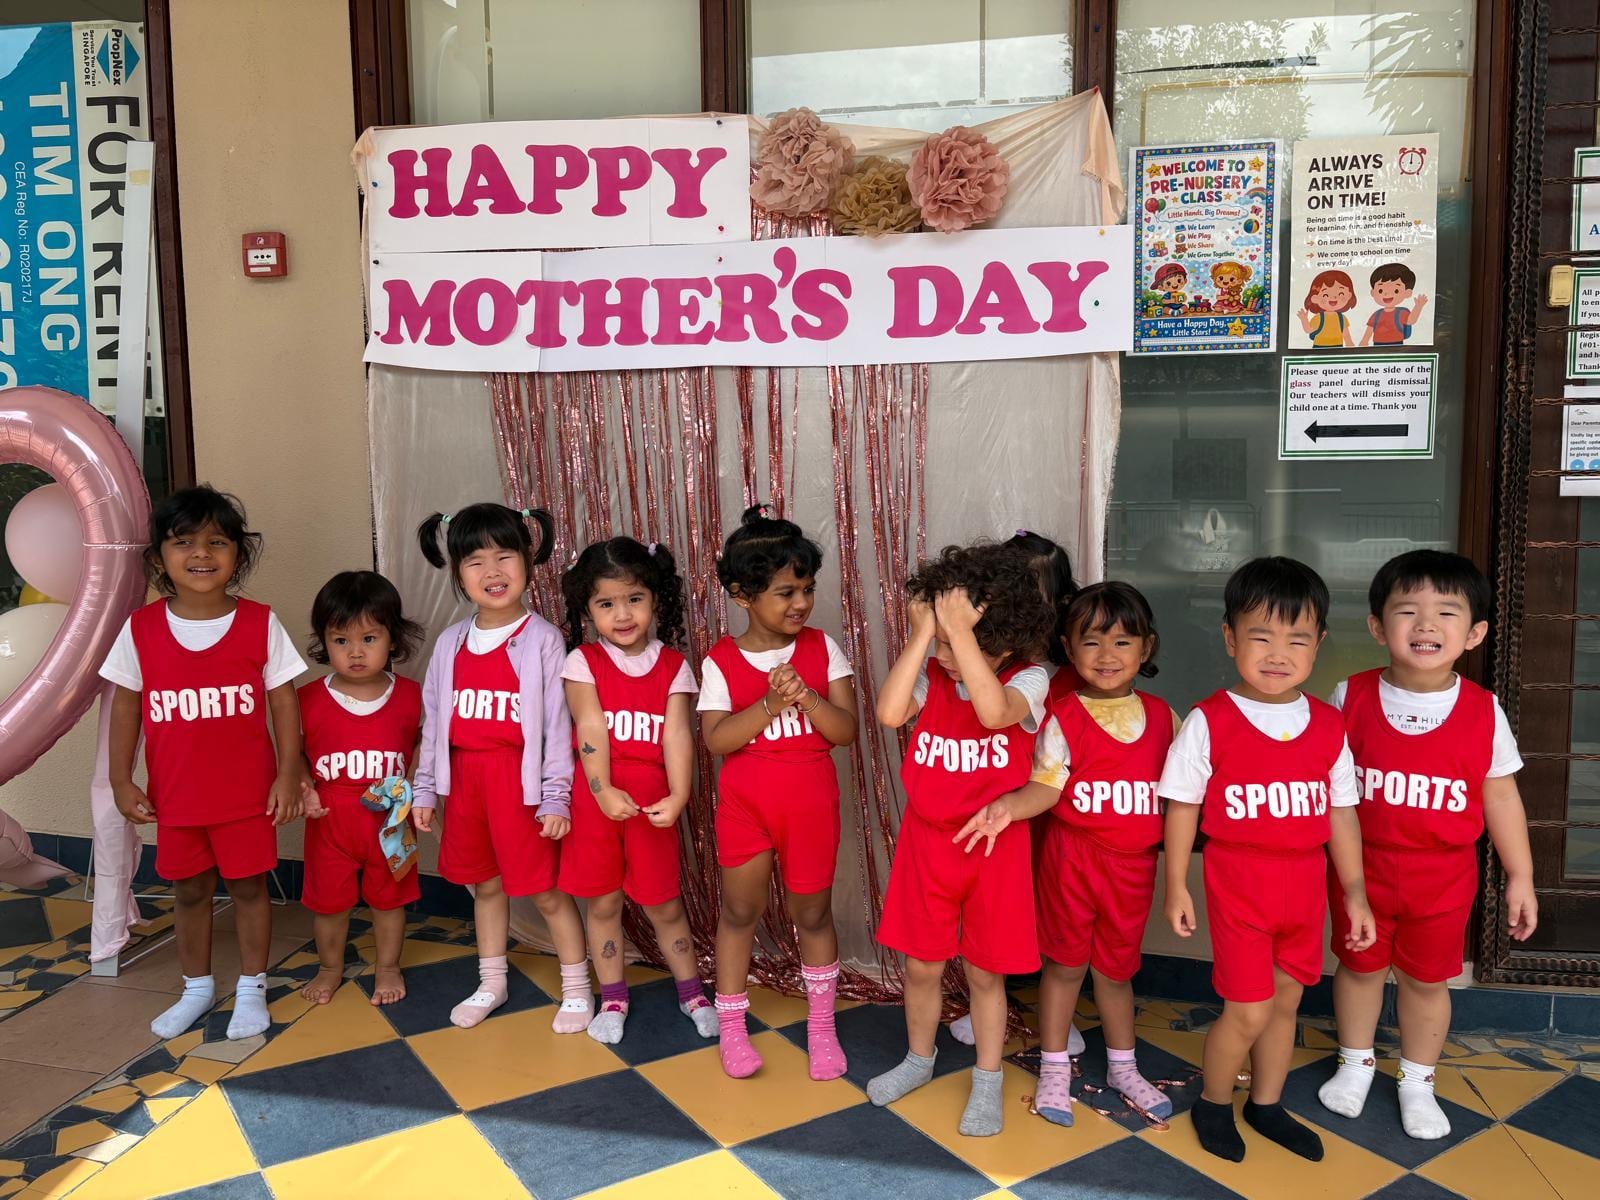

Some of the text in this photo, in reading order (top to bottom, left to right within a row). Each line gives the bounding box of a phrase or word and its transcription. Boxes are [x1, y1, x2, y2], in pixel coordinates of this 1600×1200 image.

[82, 32, 91, 86] SINGAPORE
[110, 28, 123, 86] PropNex
[1162, 157, 1246, 177] WELCOME TO
[1308, 153, 1384, 173] ALWAYS
[387, 143, 728, 219] HAPPY
[1150, 175, 1252, 195] PRE-NURSERY
[1307, 173, 1374, 192] ARRIVE
[1180, 190, 1223, 205] CLASS
[1307, 191, 1386, 210] ON TIME!
[29, 81, 81, 351] TIM ONG
[1167, 207, 1241, 219] Little Hands, Big Dreams!
[1306, 216, 1326, 225] Being
[1338, 214, 1353, 222] time
[1368, 213, 1386, 222] good
[1387, 211, 1406, 220] habit
[14, 161, 33, 303] CEA Reg No: R020217J
[1198, 223, 1216, 231] Learn
[1306, 225, 1316, 233] for
[1363, 221, 1377, 230] and
[1378, 219, 1413, 229] friendship
[1198, 232, 1212, 241] Play
[1317, 238, 1328, 246] On
[1329, 237, 1346, 245] time
[1346, 236, 1353, 244] is
[1354, 235, 1366, 244] the
[1213, 250, 1236, 260] Together
[1317, 251, 1329, 259] We
[1359, 247, 1384, 256] school
[1395, 246, 1411, 254] time
[1317, 259, 1336, 268] every
[381, 246, 1110, 349] MOTHER'S DAY
[1582, 288, 1593, 296] All
[1581, 310, 1588, 318] If
[1157, 320, 1176, 329] Have
[1184, 318, 1208, 330] Happy
[1209, 318, 1227, 328] Day,
[1172, 328, 1211, 337] Little Stars!
[1578, 351, 1593, 359] and
[1290, 364, 1431, 377] Please queue at the side of the
[1290, 376, 1431, 390] glass panel during dismissal.
[1289, 389, 1431, 400] Our teachers will dismiss your
[1289, 403, 1311, 412] child
[1312, 403, 1329, 411] one
[1330, 403, 1339, 411] at
[1347, 402, 1370, 411] time.
[1371, 402, 1400, 411] Thank
[1401, 403, 1417, 412] you
[149, 683, 255, 723] SPORTS
[914, 731, 1009, 773] SPORTS
[1072, 779, 1164, 816] SPORT
[1224, 780, 1328, 821] SPORTS
